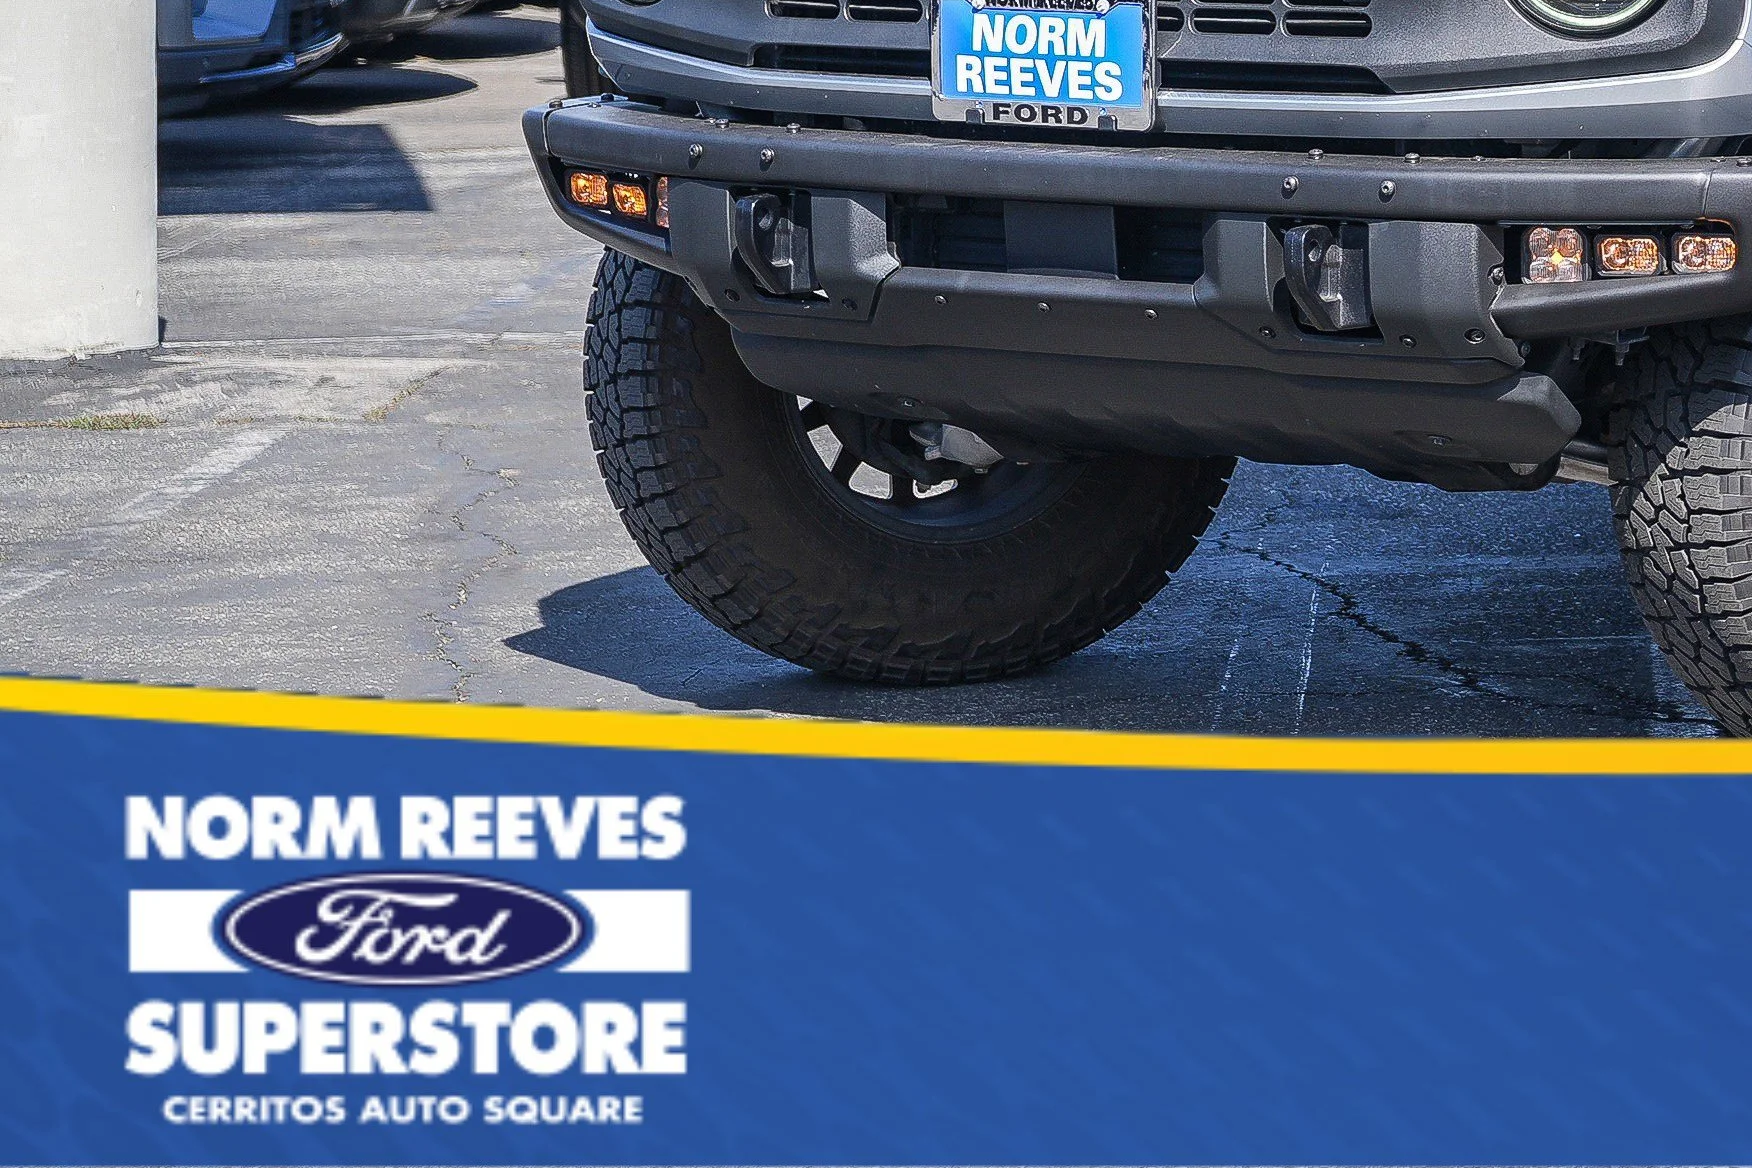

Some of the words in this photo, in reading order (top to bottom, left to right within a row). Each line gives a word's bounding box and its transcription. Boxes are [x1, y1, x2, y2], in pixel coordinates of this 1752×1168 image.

[972, 13, 1107, 58] NORM
[956, 54, 1123, 101] REEVES
[992, 103, 1089, 125] FORD
